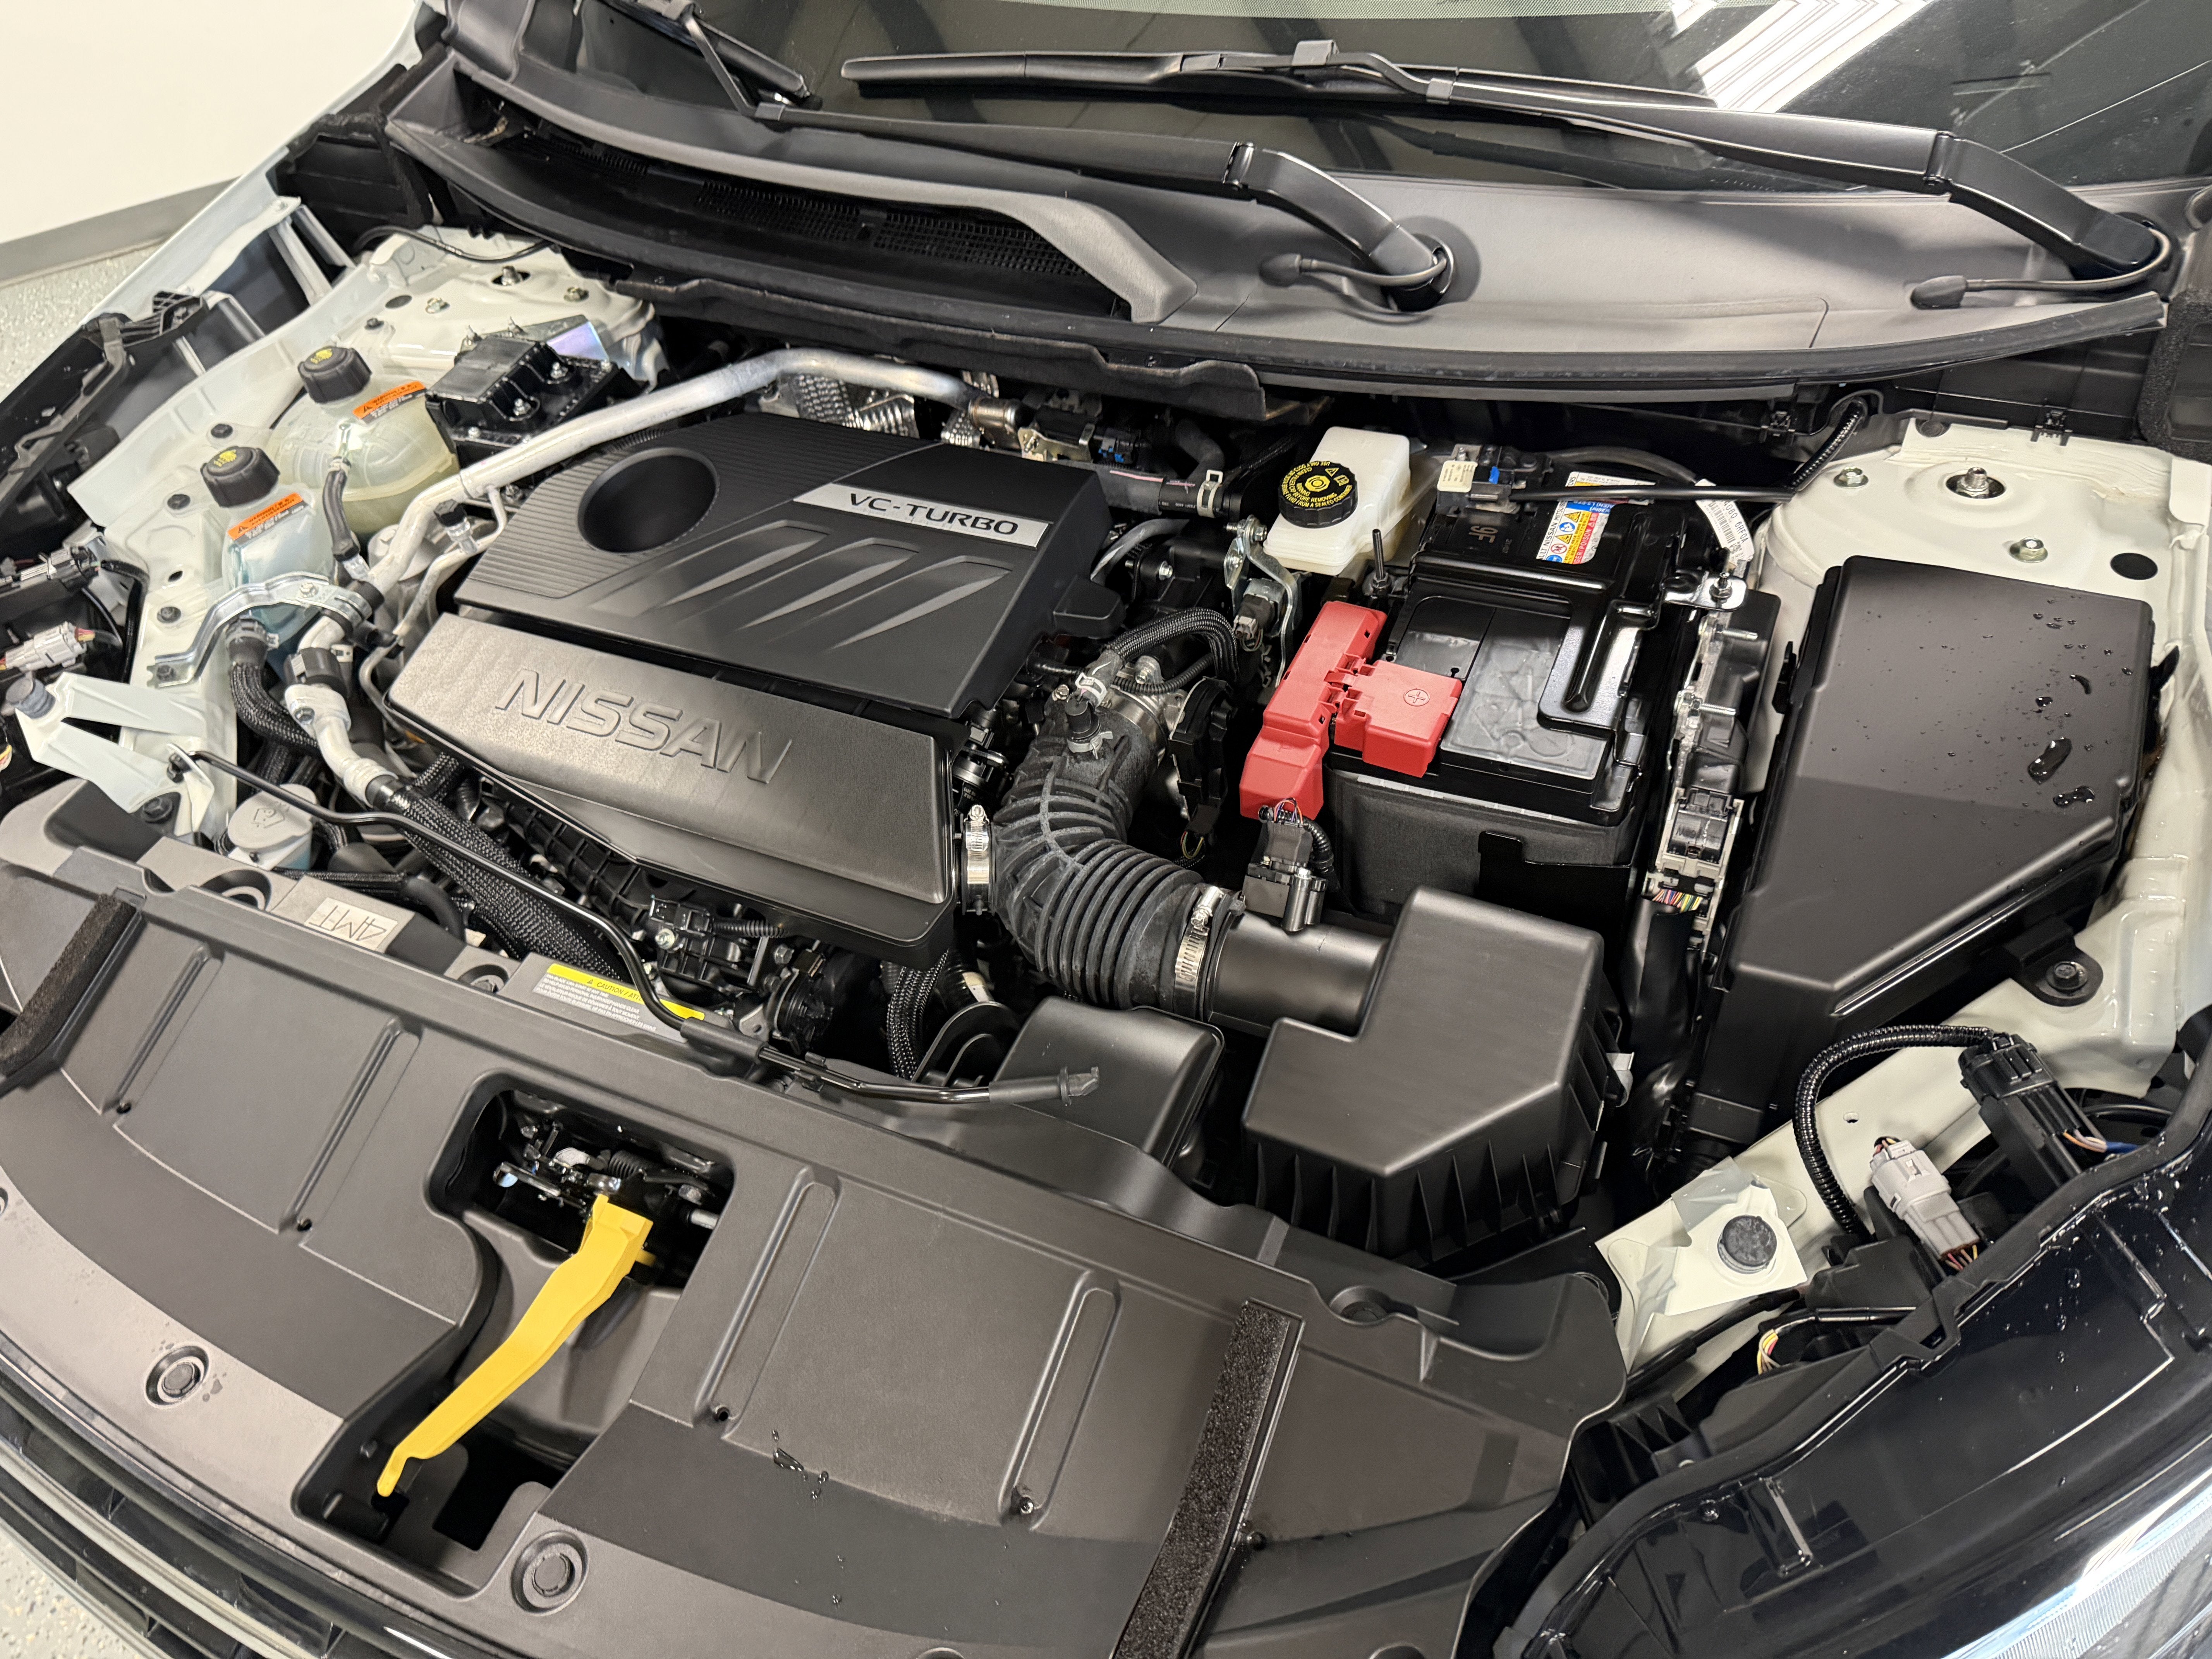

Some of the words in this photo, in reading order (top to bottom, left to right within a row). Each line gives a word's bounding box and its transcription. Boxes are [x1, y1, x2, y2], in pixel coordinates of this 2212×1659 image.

[851, 493, 1018, 535] VC-TURBO
[1468, 526, 1498, 543] 9F
[1543, 522, 1558, 546] NISSAN
[495, 668, 793, 784] NISSAN
[308, 905, 387, 941] 4MT
[597, 982, 624, 995] CAUTION
